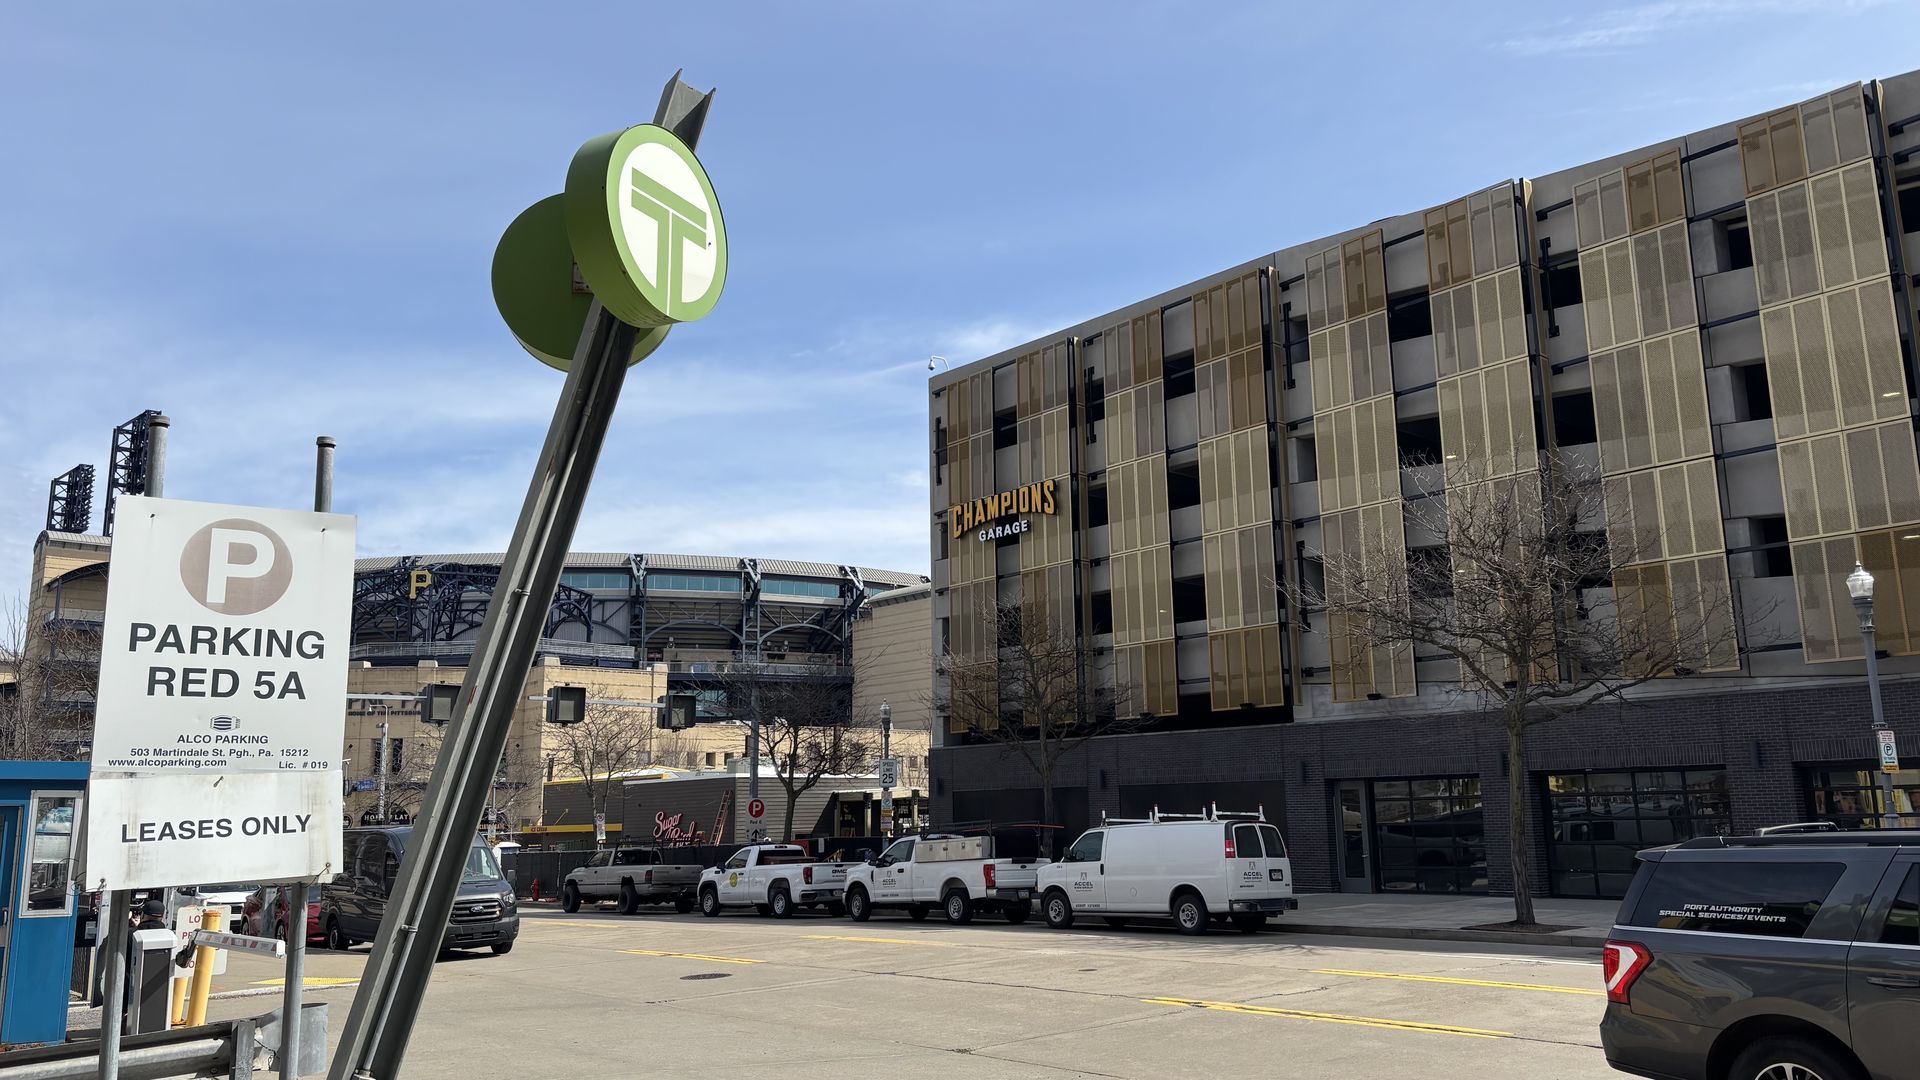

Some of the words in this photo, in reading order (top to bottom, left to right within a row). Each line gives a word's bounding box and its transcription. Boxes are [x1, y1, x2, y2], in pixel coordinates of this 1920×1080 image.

[952, 479, 1056, 539] CHAMPIONS
[979, 520, 1029, 542] GARAGE
[206, 527, 276, 604] P
[409, 570, 432, 599] P
[129, 622, 325, 659] PARKING
[146, 666, 239, 698] RED
[253, 671, 306, 700] 5A
[177, 734, 212, 745] ALCO
[215, 735, 269, 745] PARKING
[130, 748, 150, 757] 503
[153, 748, 209, 757] Martindale
[211, 748, 226, 757] St.
[229, 748, 255, 759] Pgh.,
[258, 749, 274, 757] Pa.
[280, 749, 309, 757] 15212
[108, 758, 227, 768] www.alcoparking.com
[279, 761, 297, 769] Lic.
[310, 761, 329, 769] 019
[882, 773, 894, 783] 25
[121, 818, 232, 843] LEASES
[241, 814, 311, 836] ONLY
[653, 811, 682, 838] Sugar
[1698, 912, 1786, 922] SERVICES/EVENTS
[1709, 905, 1763, 913] AUTHORITY
[188, 914, 204, 924] LO
